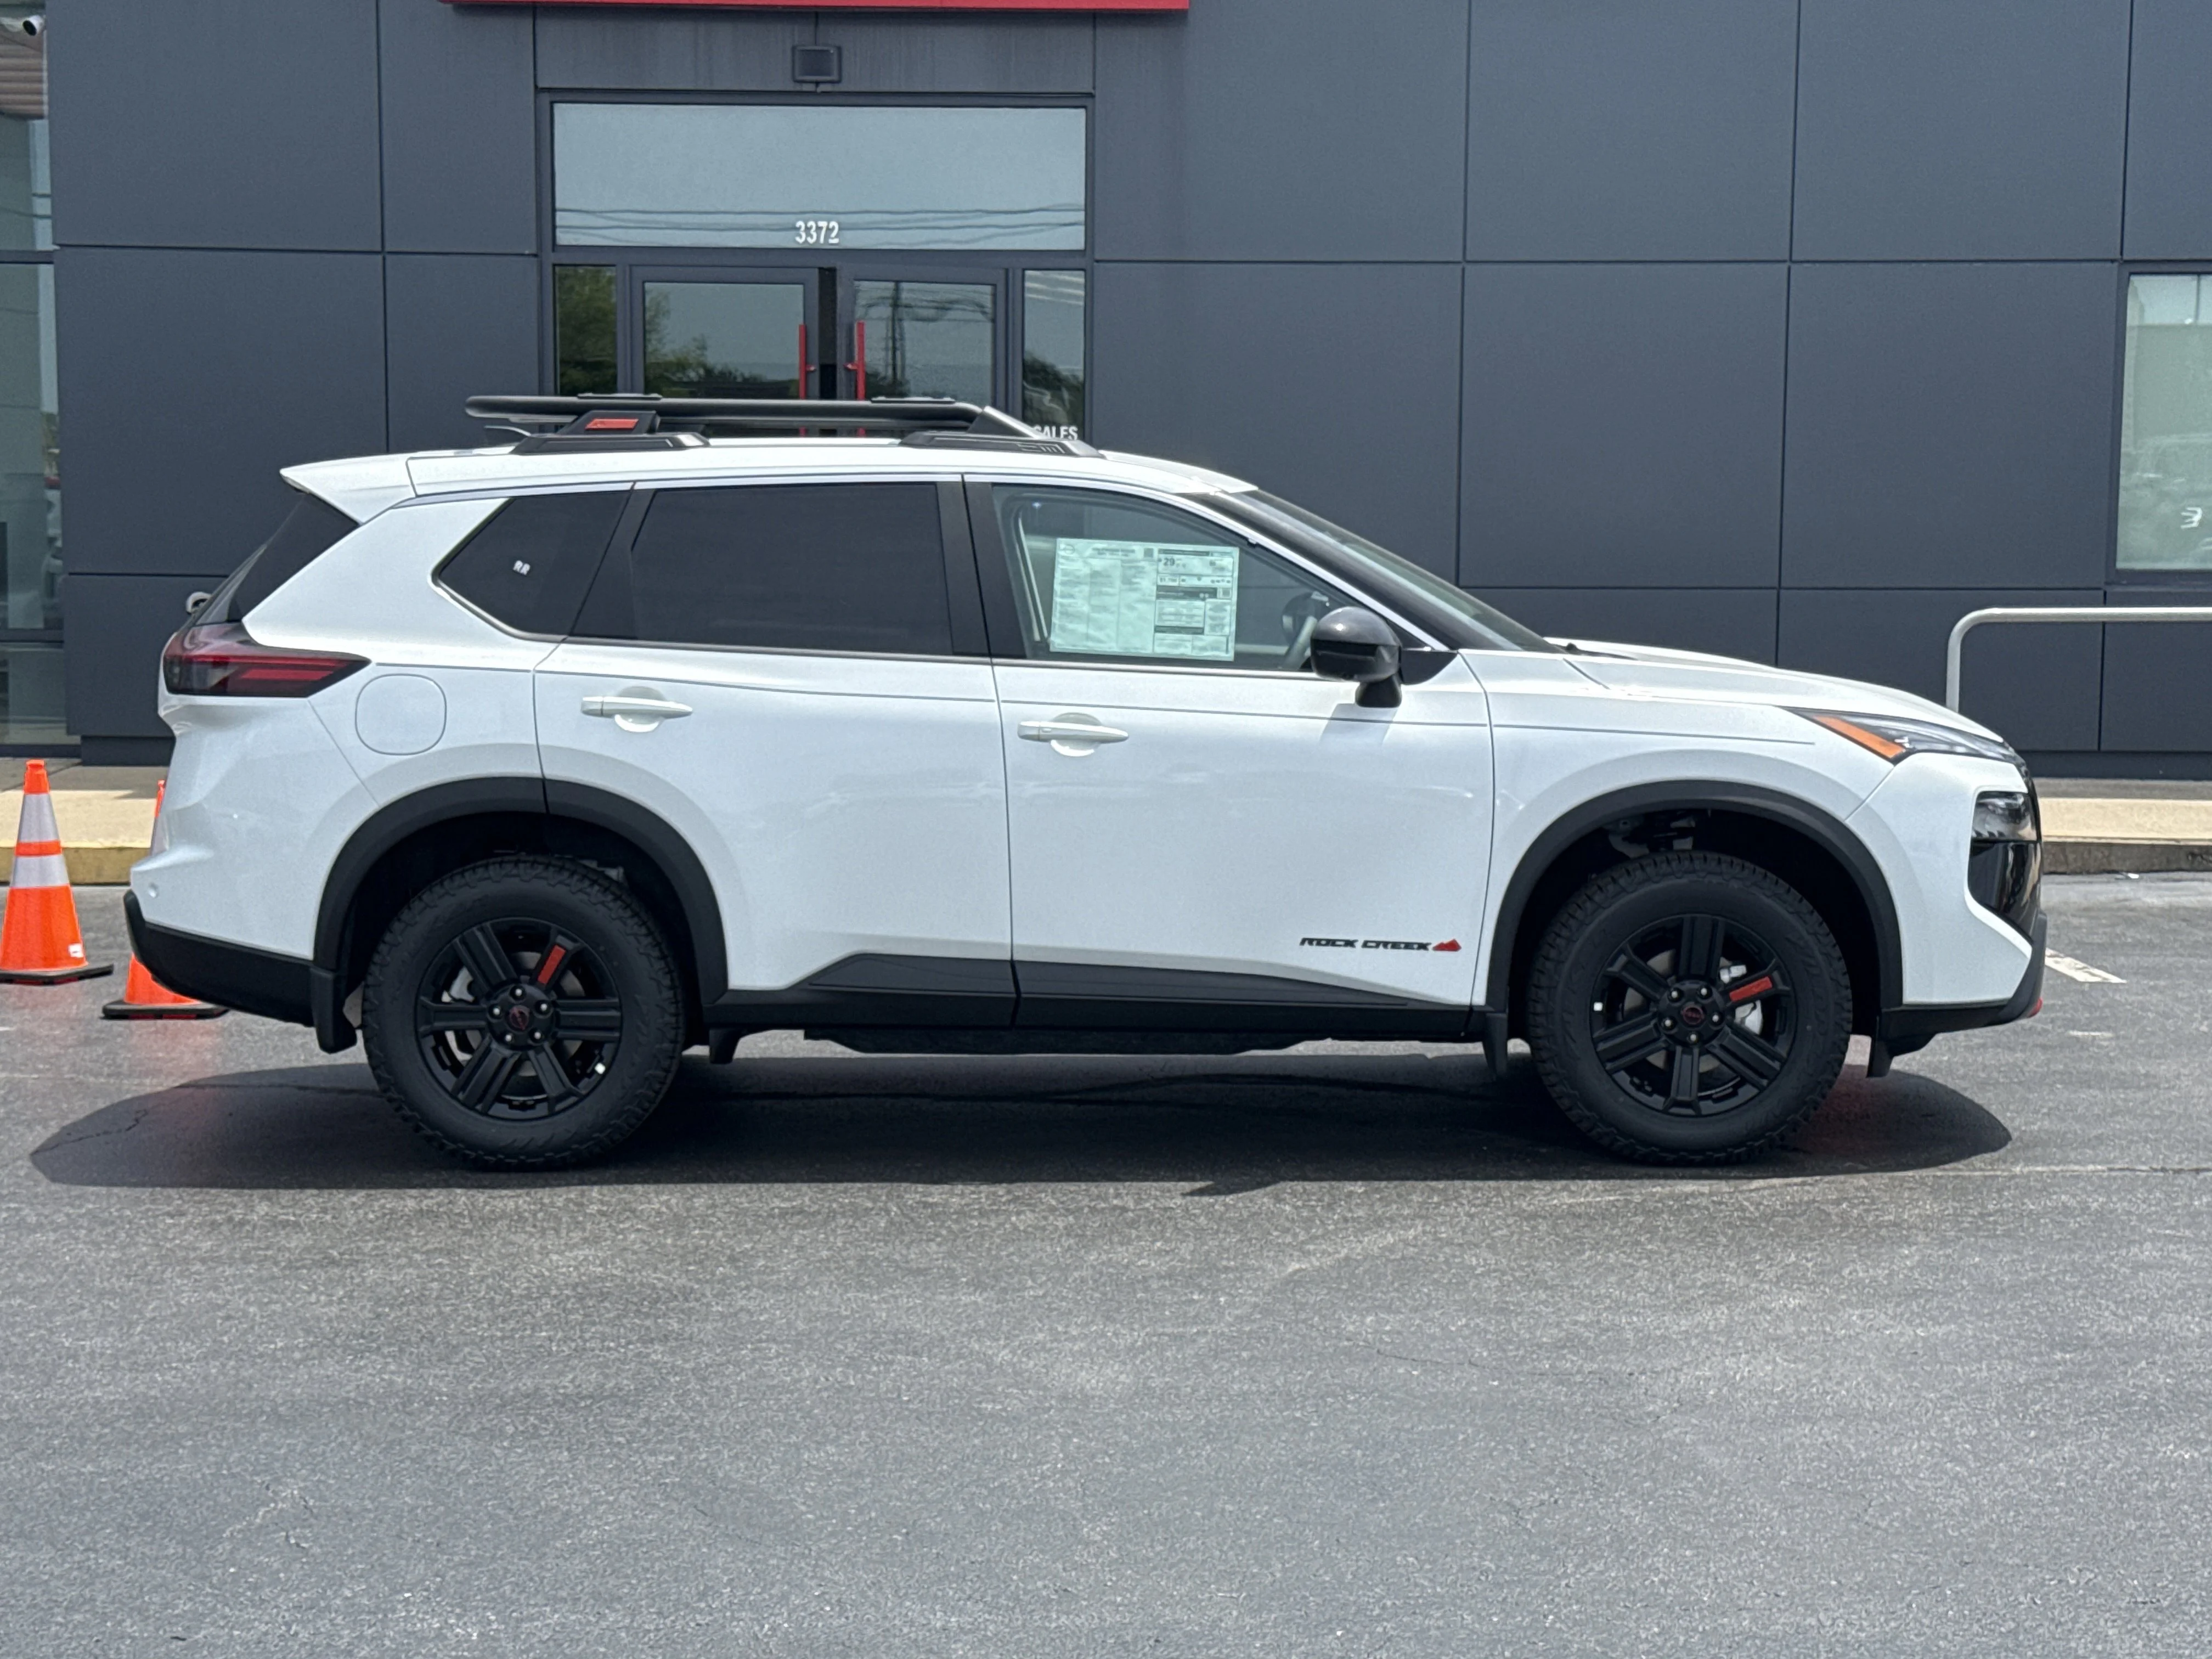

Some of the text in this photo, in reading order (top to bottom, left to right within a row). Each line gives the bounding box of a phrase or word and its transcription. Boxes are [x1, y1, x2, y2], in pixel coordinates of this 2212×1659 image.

[795, 221, 839, 244] 3372
[1299, 937, 1432, 951] ROCK CREEK
